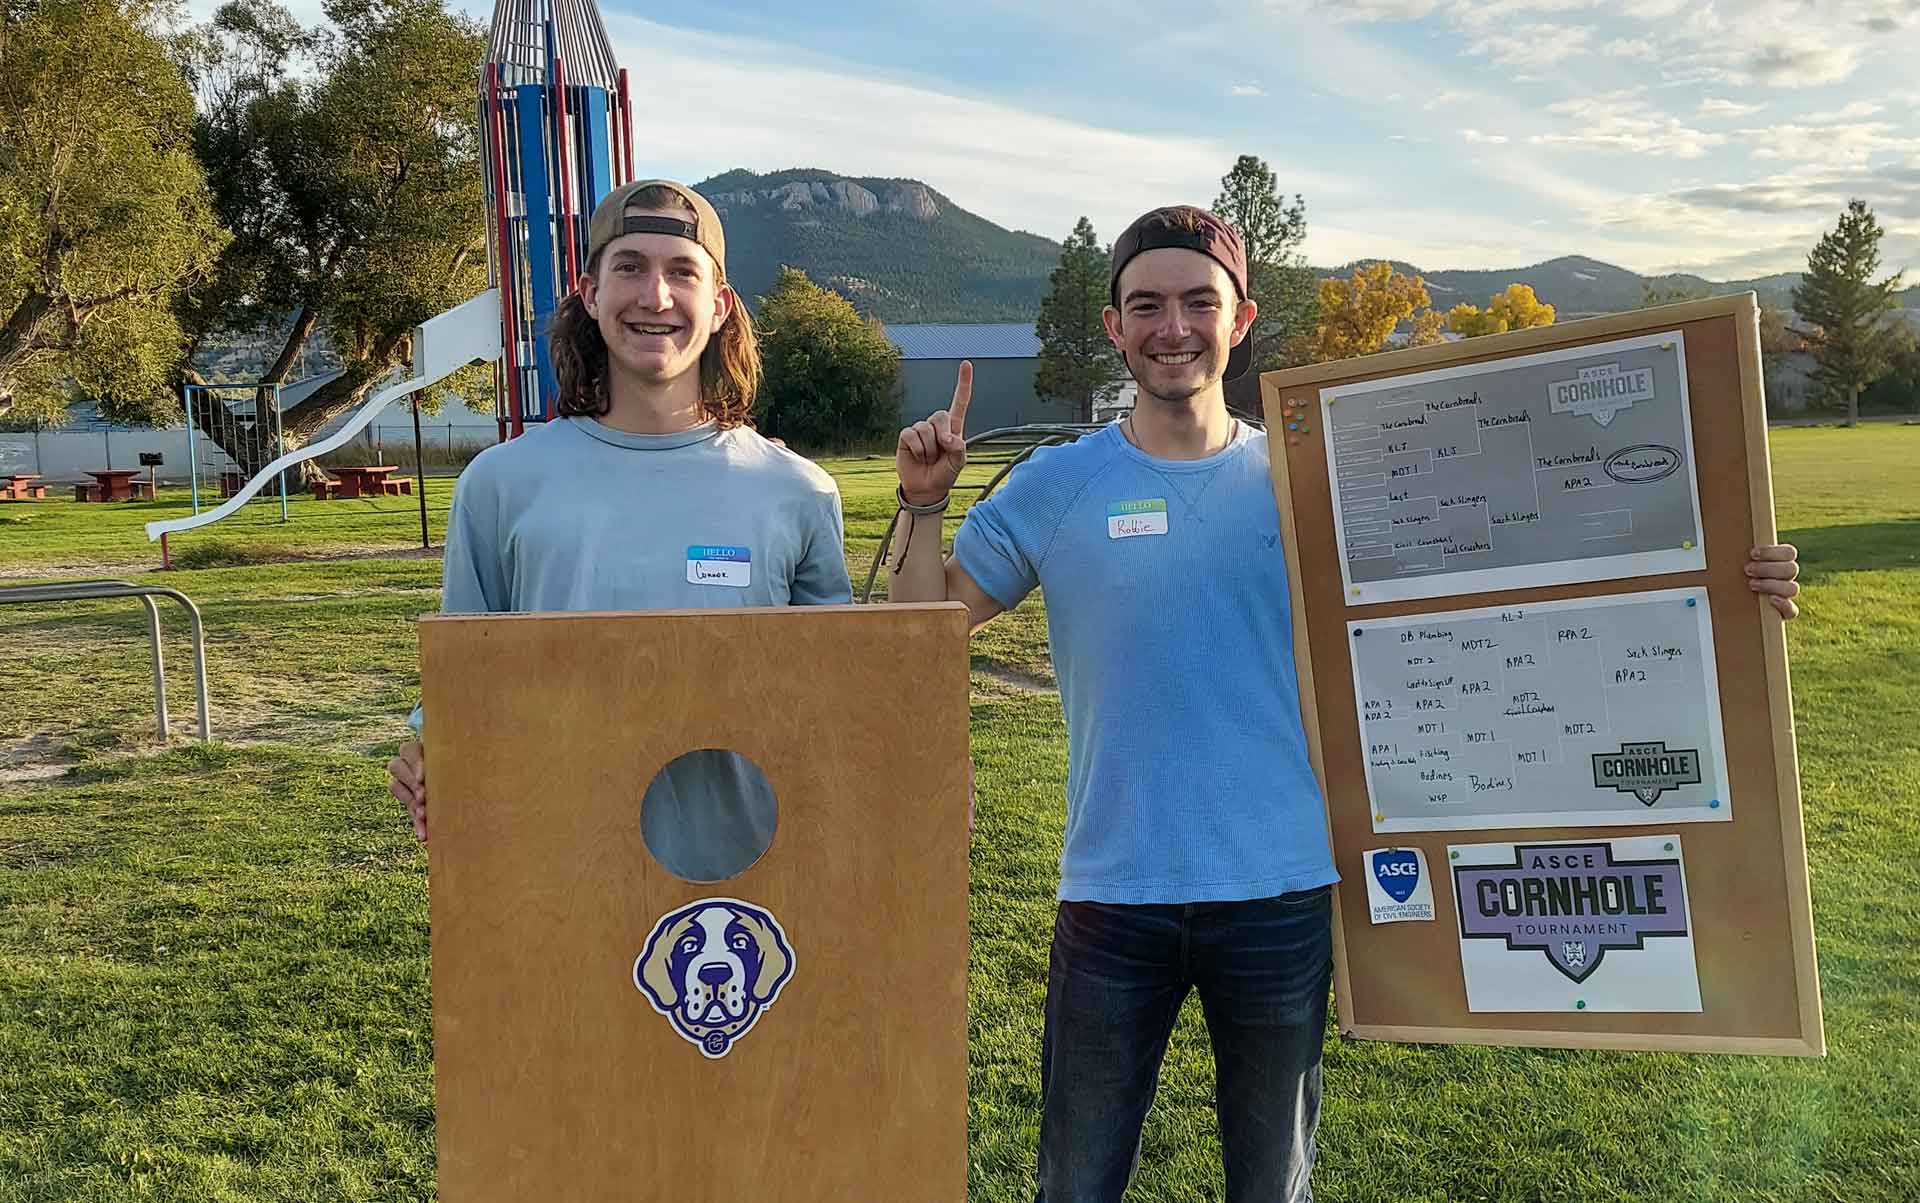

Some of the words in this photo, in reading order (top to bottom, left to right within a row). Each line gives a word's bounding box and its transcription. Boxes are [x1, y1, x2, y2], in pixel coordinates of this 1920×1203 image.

[1557, 373, 1648, 404] CORNHOLE
[1537, 456, 1552, 468] The
[703, 547, 736, 557] HELLO
[1603, 757, 1690, 778] CORNHOLE
[1379, 862, 1417, 877] ASCE
[1532, 854, 1595, 870] ASCE
[1476, 874, 1668, 918] CORNHOLE
[1374, 904, 1406, 913] AMERICAN
[1516, 923, 1629, 936] TOURNAMENT
